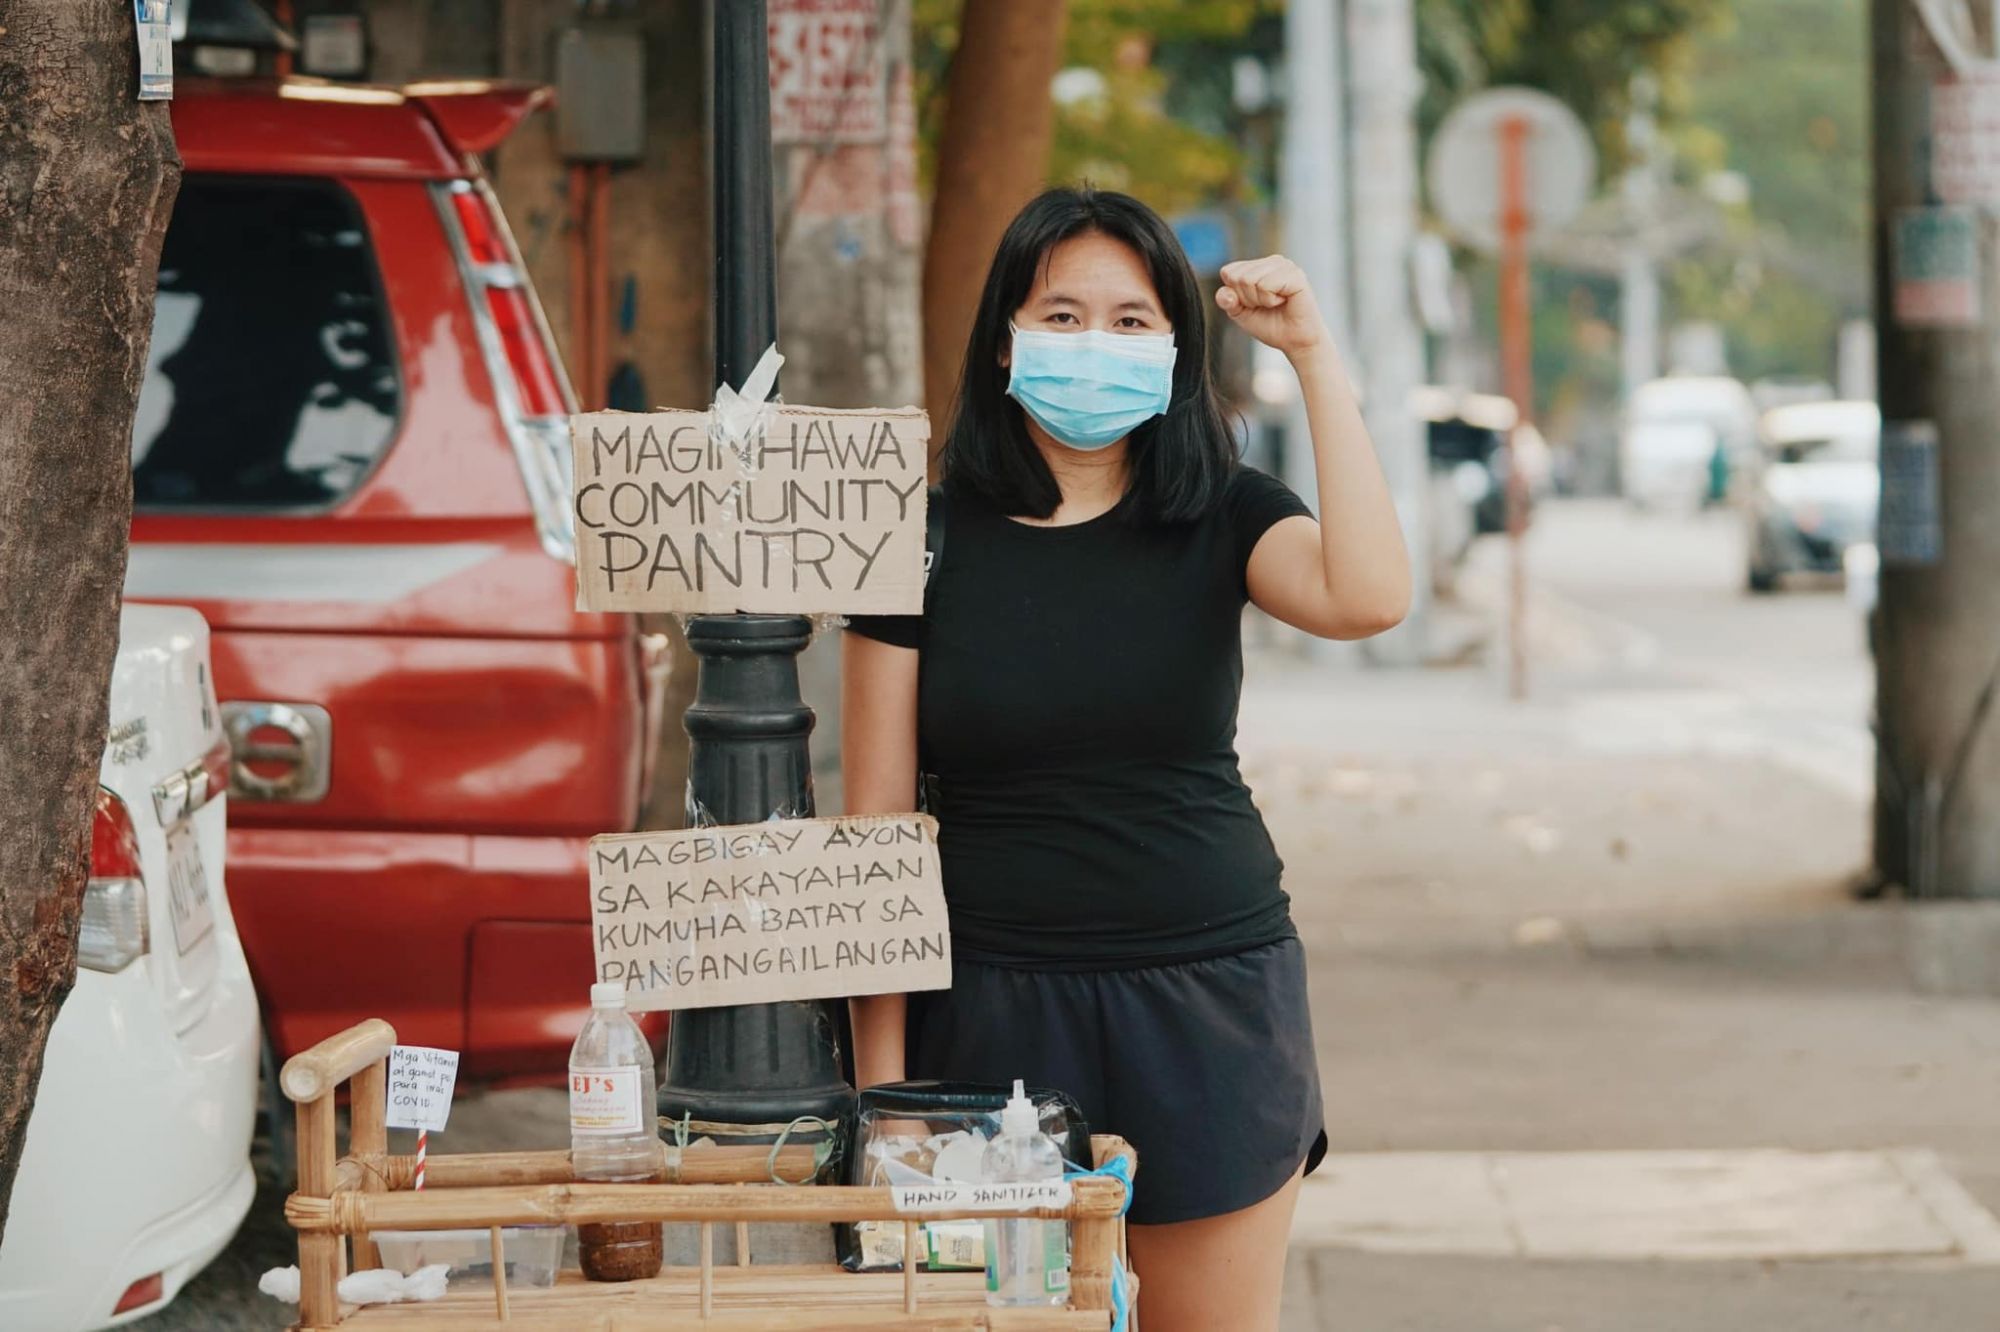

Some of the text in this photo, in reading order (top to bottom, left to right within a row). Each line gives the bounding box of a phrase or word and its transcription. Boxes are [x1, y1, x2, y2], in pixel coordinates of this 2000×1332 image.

[576, 476, 924, 528] COMMUNITY
[598, 528, 893, 592] PANTRY
[596, 822, 923, 875] MAGBIGAY AYON
[597, 856, 923, 914] SA KAKAYAHAN
[599, 894, 924, 952] KUMUHA BATAY SA
[601, 932, 945, 992] PANGANGAILANGAN
[392, 1065, 405, 1077] at
[393, 1049, 418, 1066] Mga
[393, 1080, 418, 1093] para
[904, 1187, 1058, 1206] HAND SANITIZER
